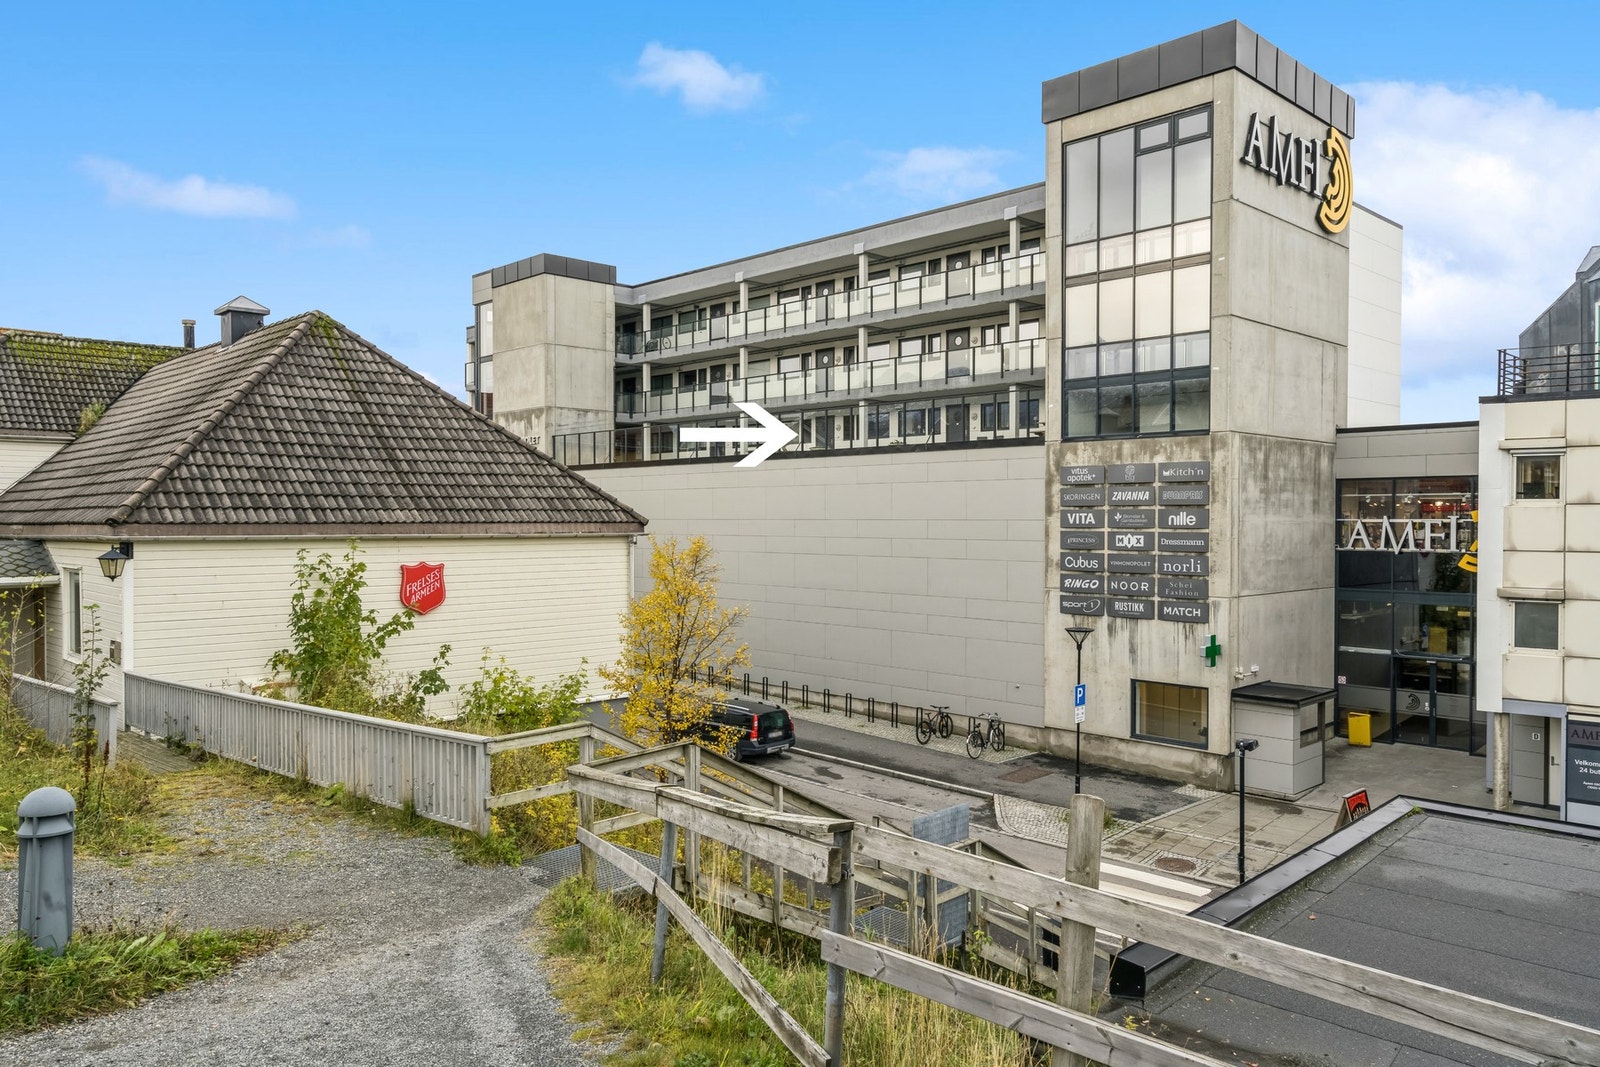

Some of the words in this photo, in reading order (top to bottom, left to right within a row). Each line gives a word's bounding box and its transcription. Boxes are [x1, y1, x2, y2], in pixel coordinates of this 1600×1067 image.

[1241, 112, 1323, 200] AMFI
[1071, 467, 1089, 475] vitus
[1063, 493, 1101, 501] SKORINGEN
[1112, 490, 1149, 501] ZAVANNA
[1067, 513, 1095, 524] VITA
[1168, 511, 1197, 526] nille
[1116, 534, 1144, 547] MIX
[1346, 515, 1460, 555] AMFI
[1161, 538, 1204, 546] Dressmann
[1064, 556, 1099, 569] Cubus
[1163, 559, 1202, 573] norli
[1063, 578, 1100, 589] RINGO
[1111, 580, 1149, 592] NOOR
[1169, 581, 1193, 589] Schei
[410, 580, 441, 604] ARMEEN
[1165, 588, 1199, 596] Fashion
[1114, 601, 1145, 612] RUSTIKK
[1163, 606, 1201, 617] MATCH
[1077, 687, 1083, 704] P
